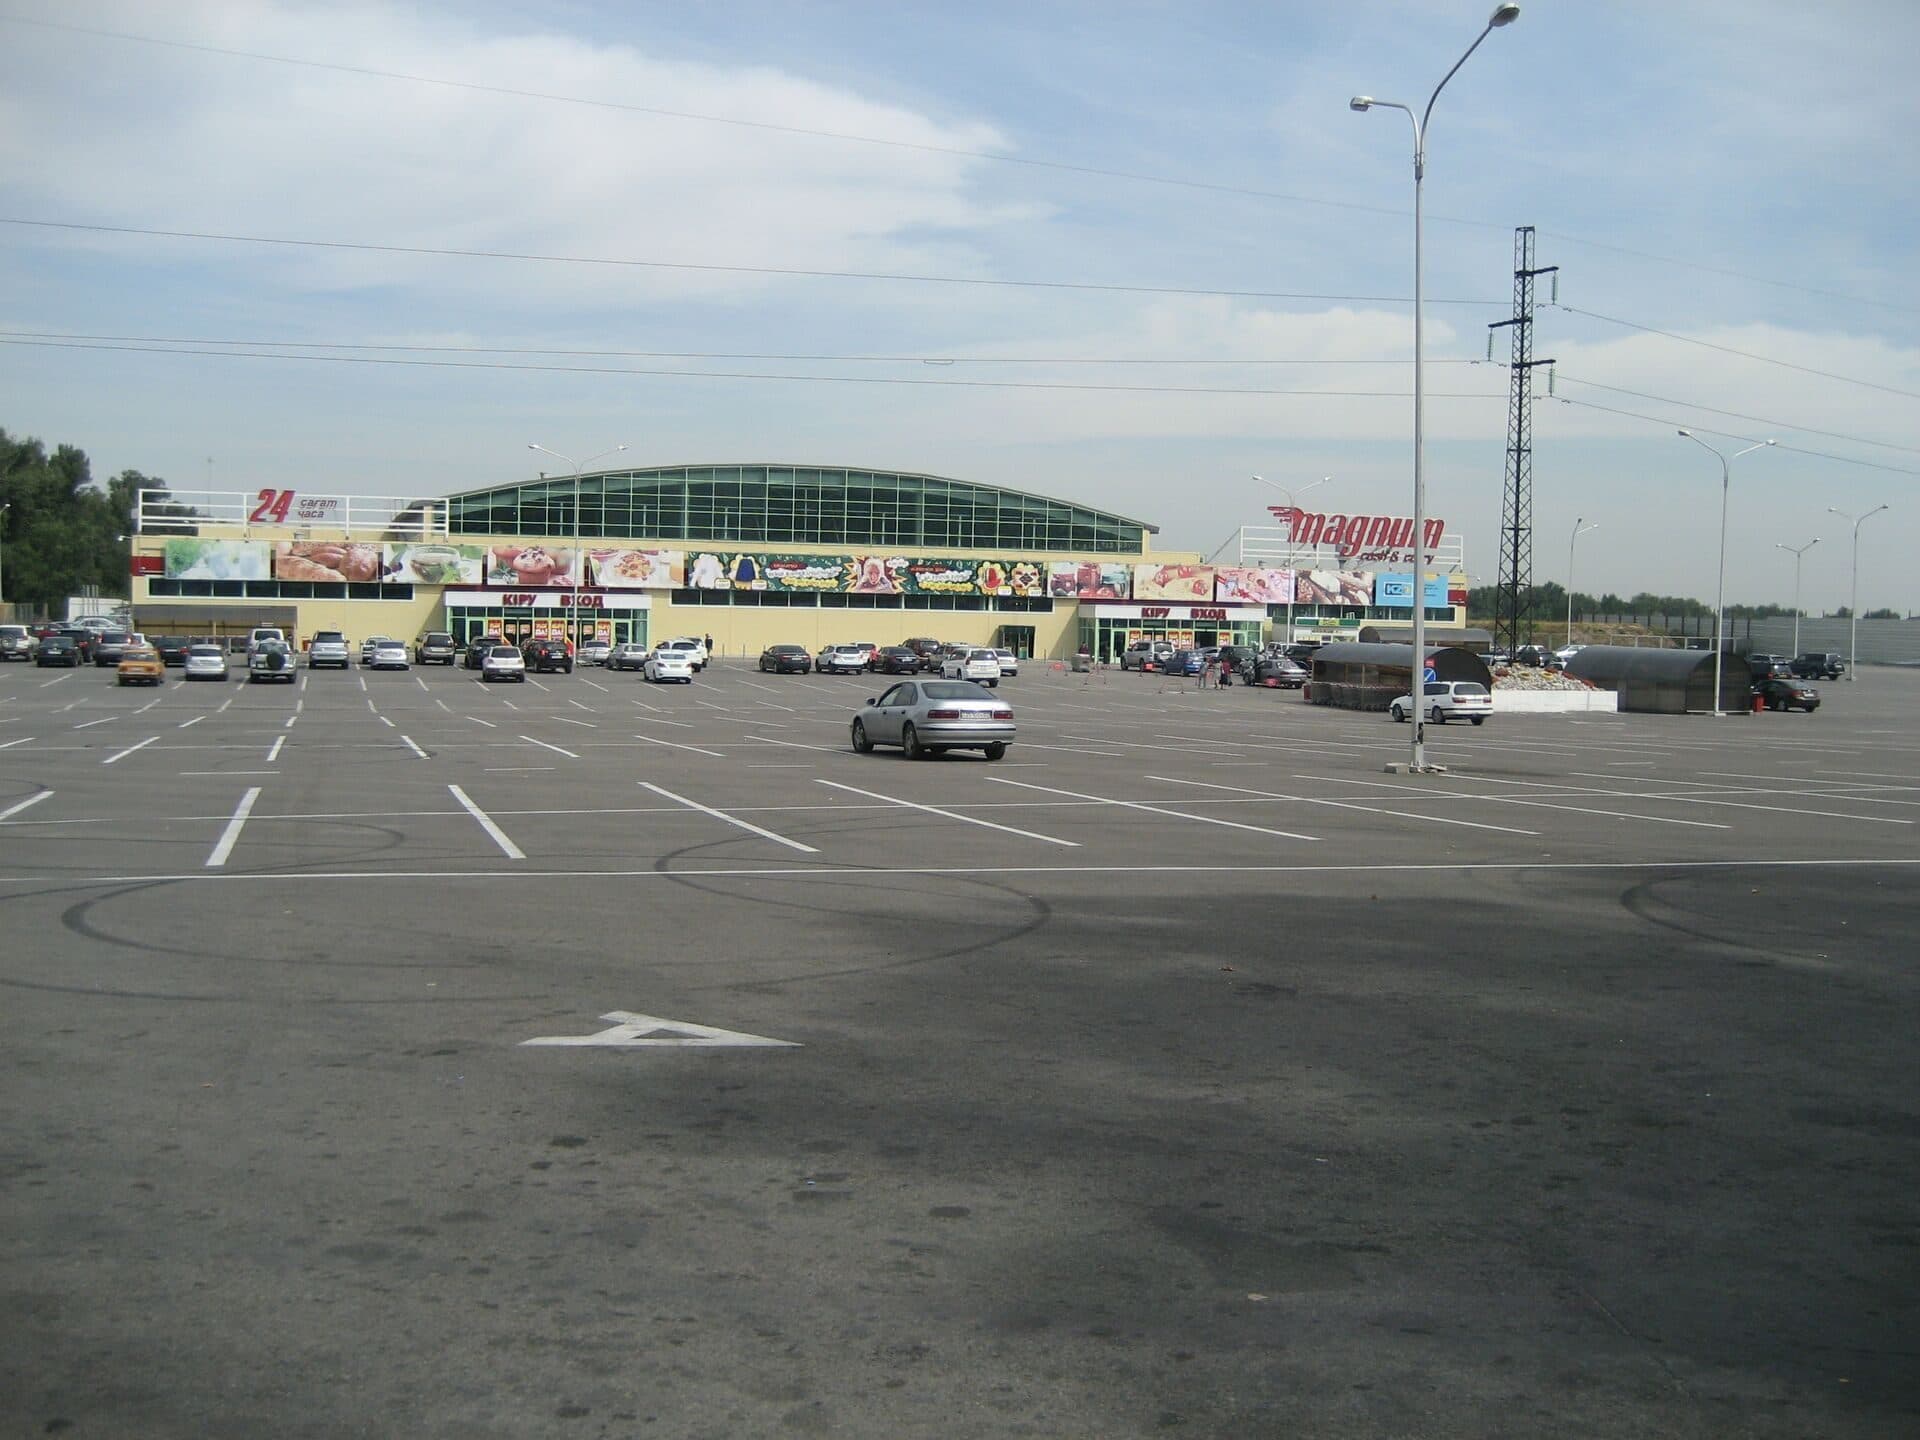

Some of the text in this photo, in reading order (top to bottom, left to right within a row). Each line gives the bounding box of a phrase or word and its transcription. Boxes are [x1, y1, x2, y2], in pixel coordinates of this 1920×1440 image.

[249, 489, 296, 523] 24
[298, 510, 325, 518] часа
[1267, 506, 1445, 557] magnum
[1403, 554, 1434, 565] cay
[560, 595, 604, 608] ВХОД
[1190, 608, 1227, 620] ВХОД
